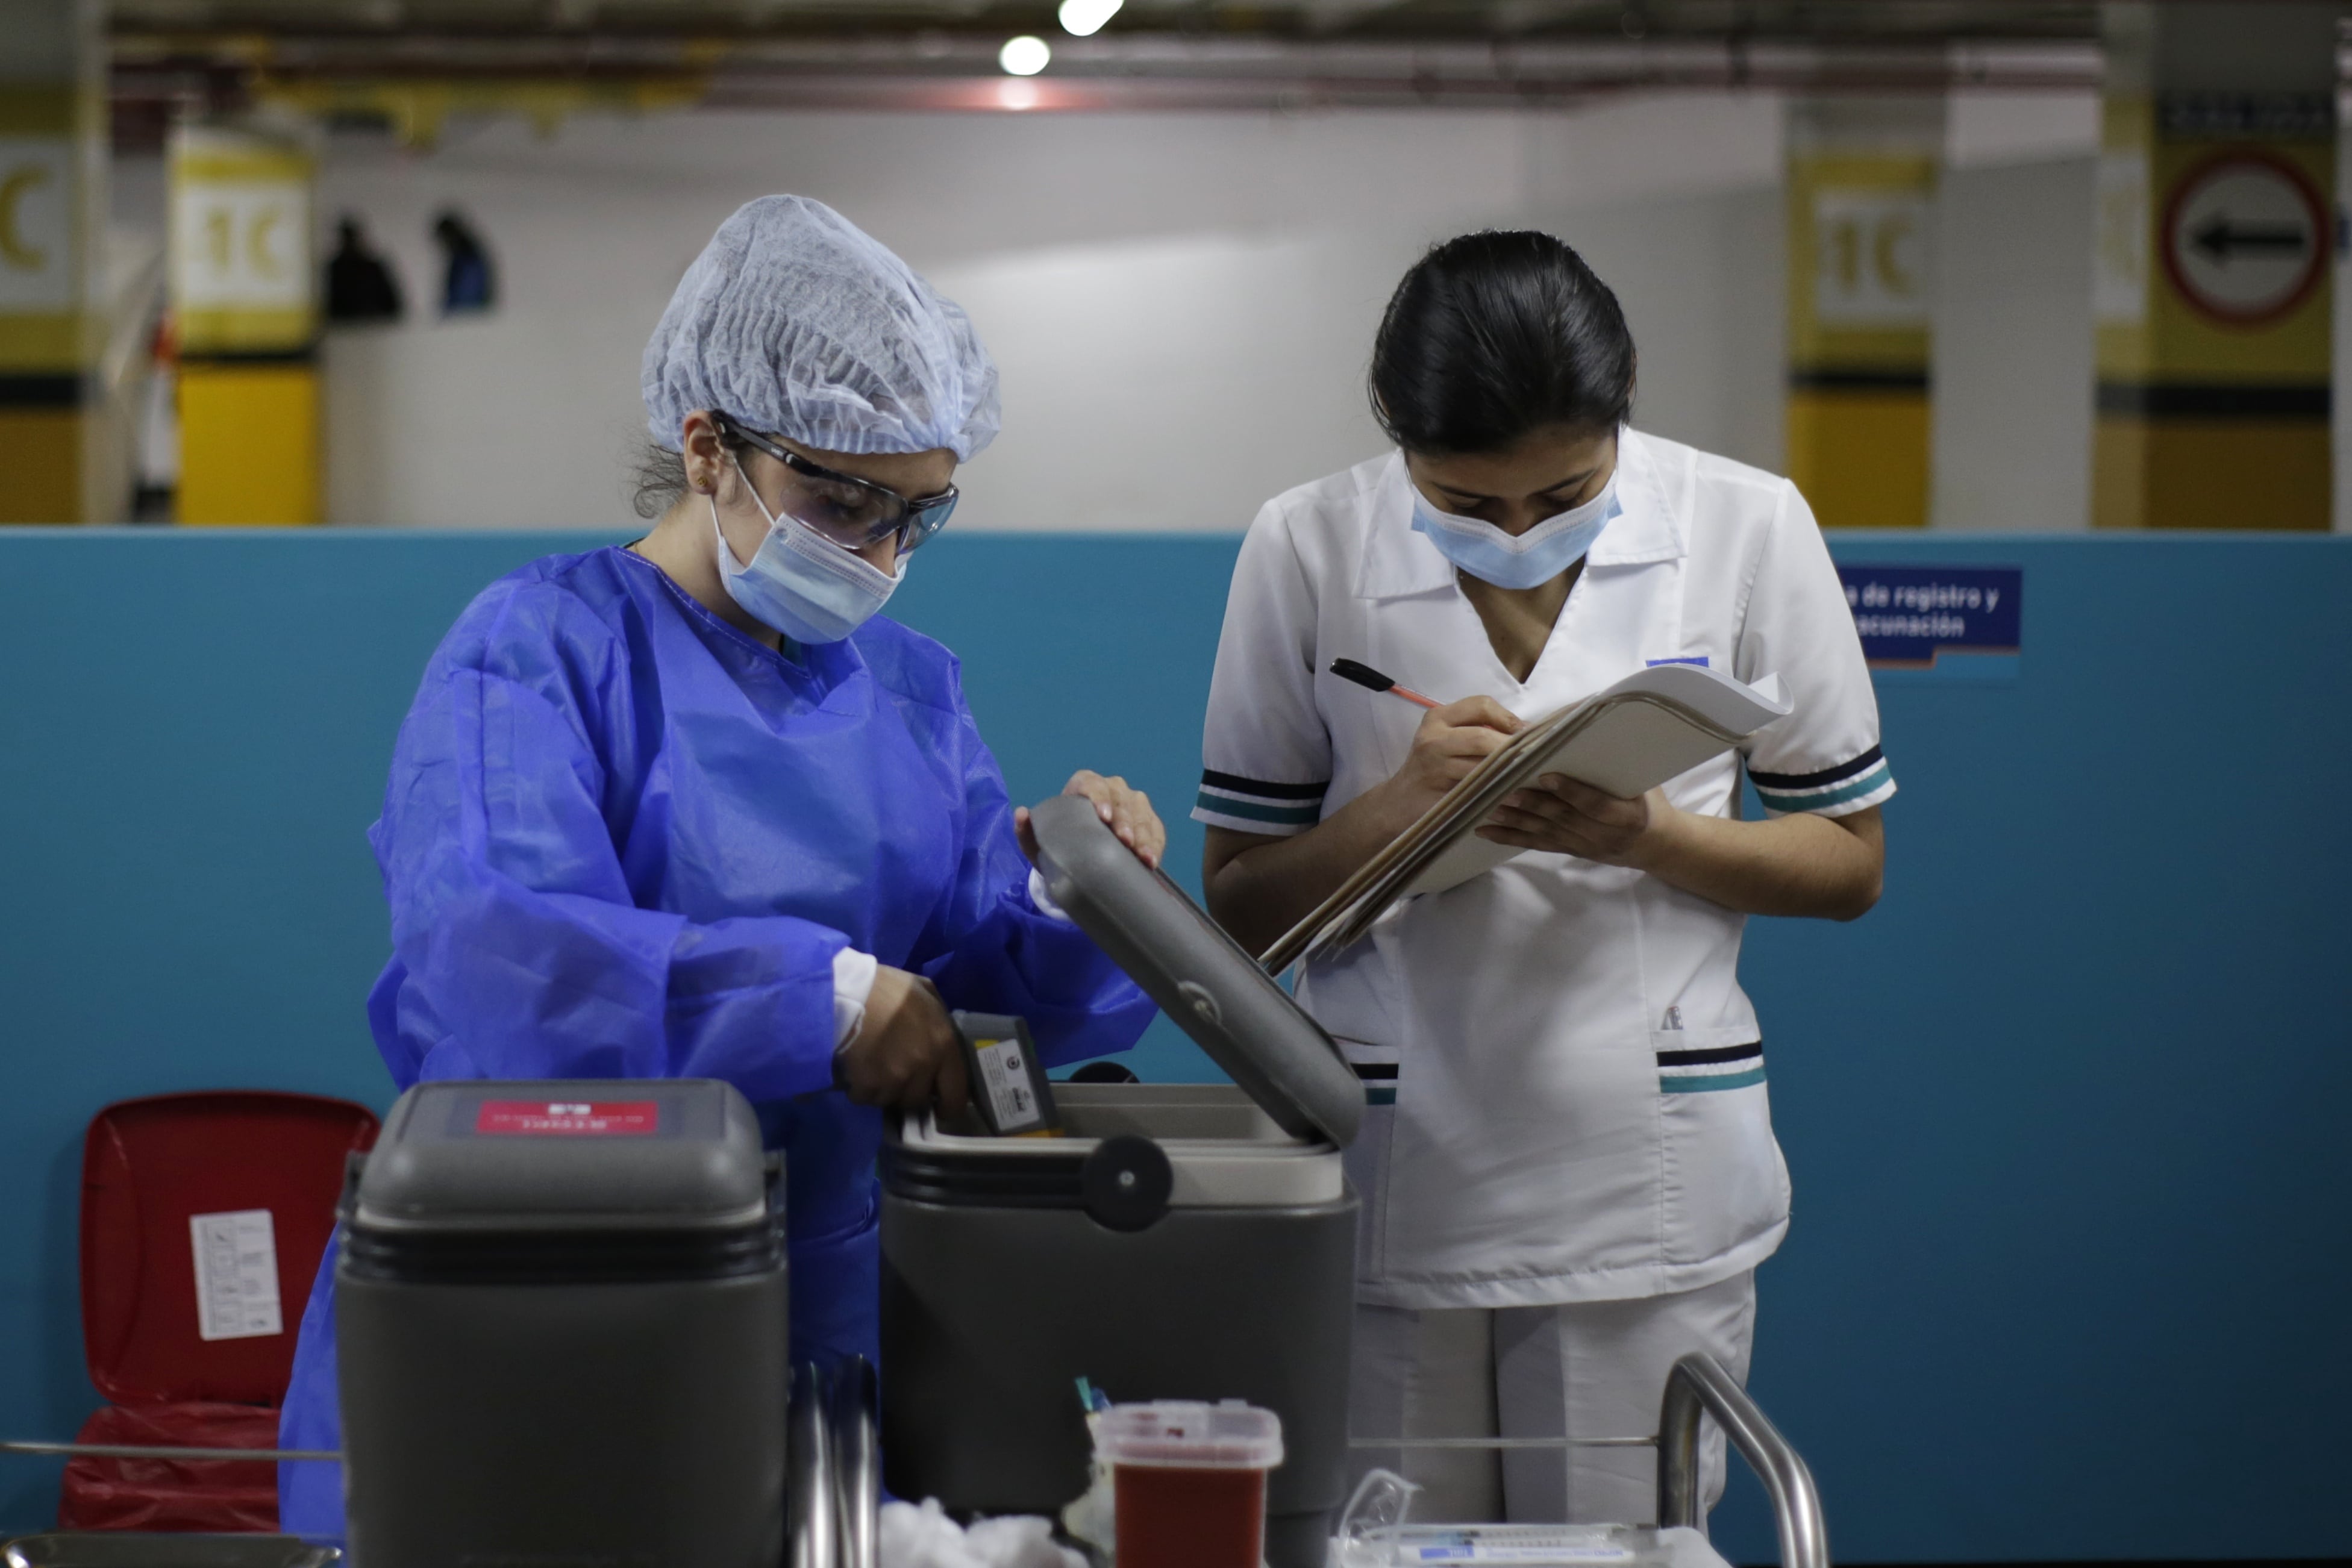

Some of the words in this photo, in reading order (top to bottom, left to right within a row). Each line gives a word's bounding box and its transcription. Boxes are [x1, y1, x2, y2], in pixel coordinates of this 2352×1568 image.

[1862, 581, 1890, 607] de
[1894, 583, 1981, 612] registro
[1986, 588, 1999, 613] y
[1854, 611, 1965, 637] acunación
